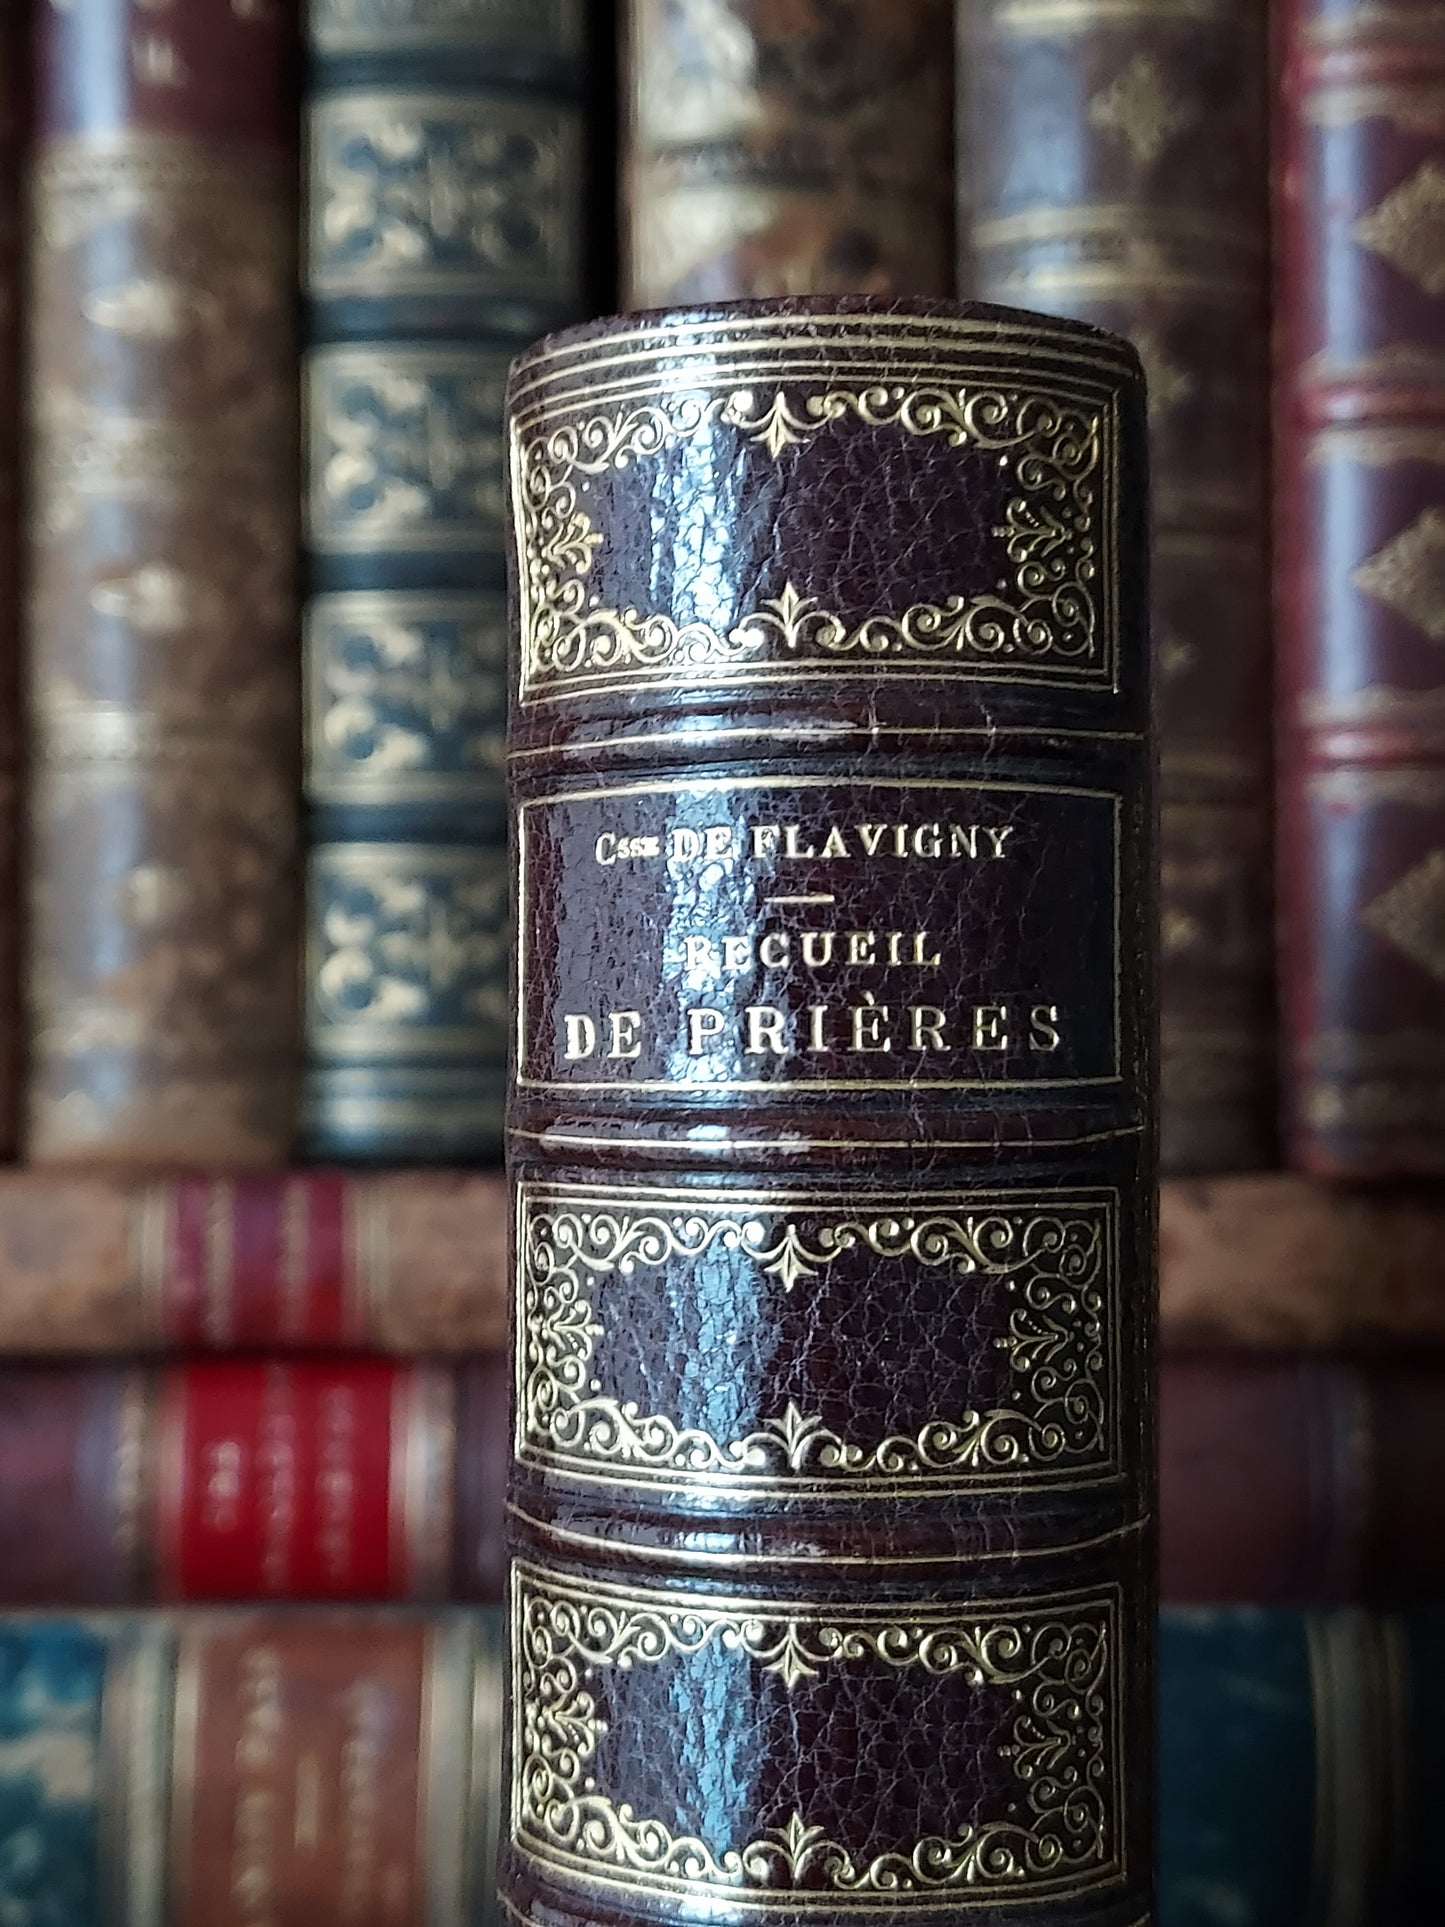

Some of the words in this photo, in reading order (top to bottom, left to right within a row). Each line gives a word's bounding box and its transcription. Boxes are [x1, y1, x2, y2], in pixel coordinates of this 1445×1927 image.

[671, 826, 733, 861] DE
[749, 823, 1014, 858] FLAVIGNY
[683, 930, 942, 969] RECUEIL
[563, 1010, 642, 1060] DE
[686, 990, 1060, 1055] PRIÈRES
